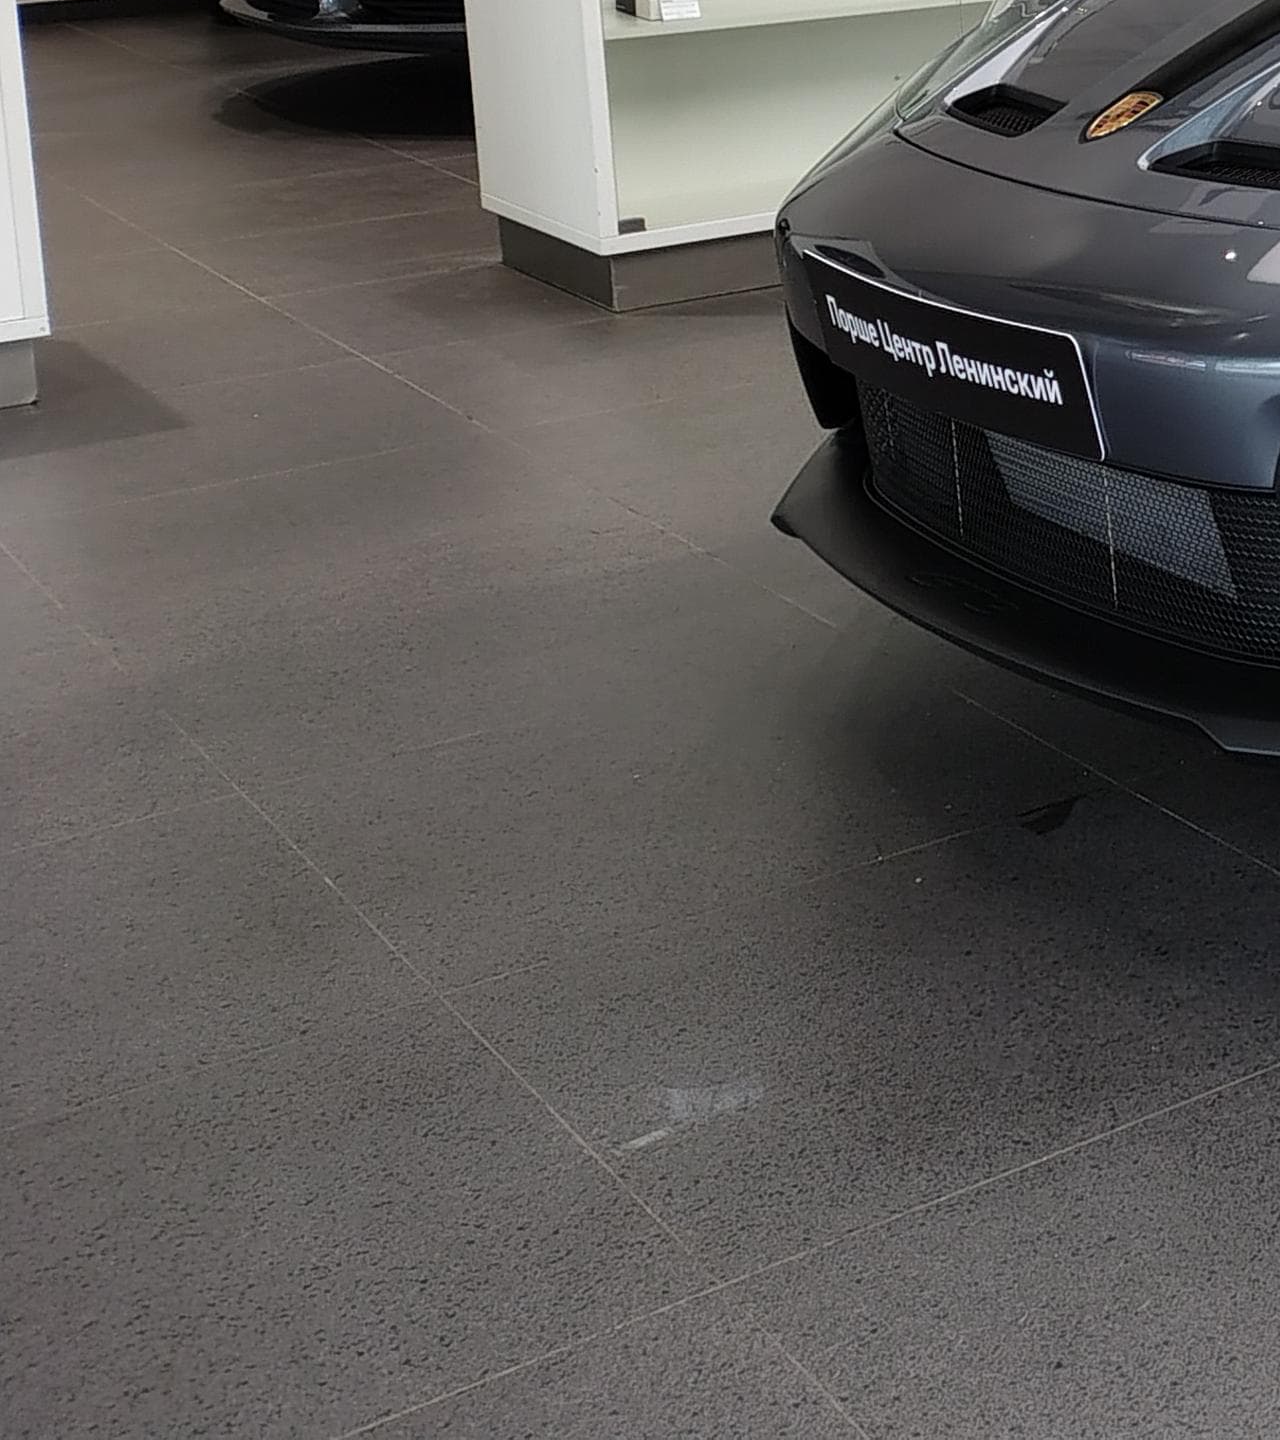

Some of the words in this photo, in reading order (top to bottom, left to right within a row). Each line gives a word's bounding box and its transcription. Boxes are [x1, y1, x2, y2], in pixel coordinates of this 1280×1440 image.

[825, 294, 881, 348] Порше
[879, 318, 937, 378] Центр
[935, 340, 1064, 406] Ленинский
